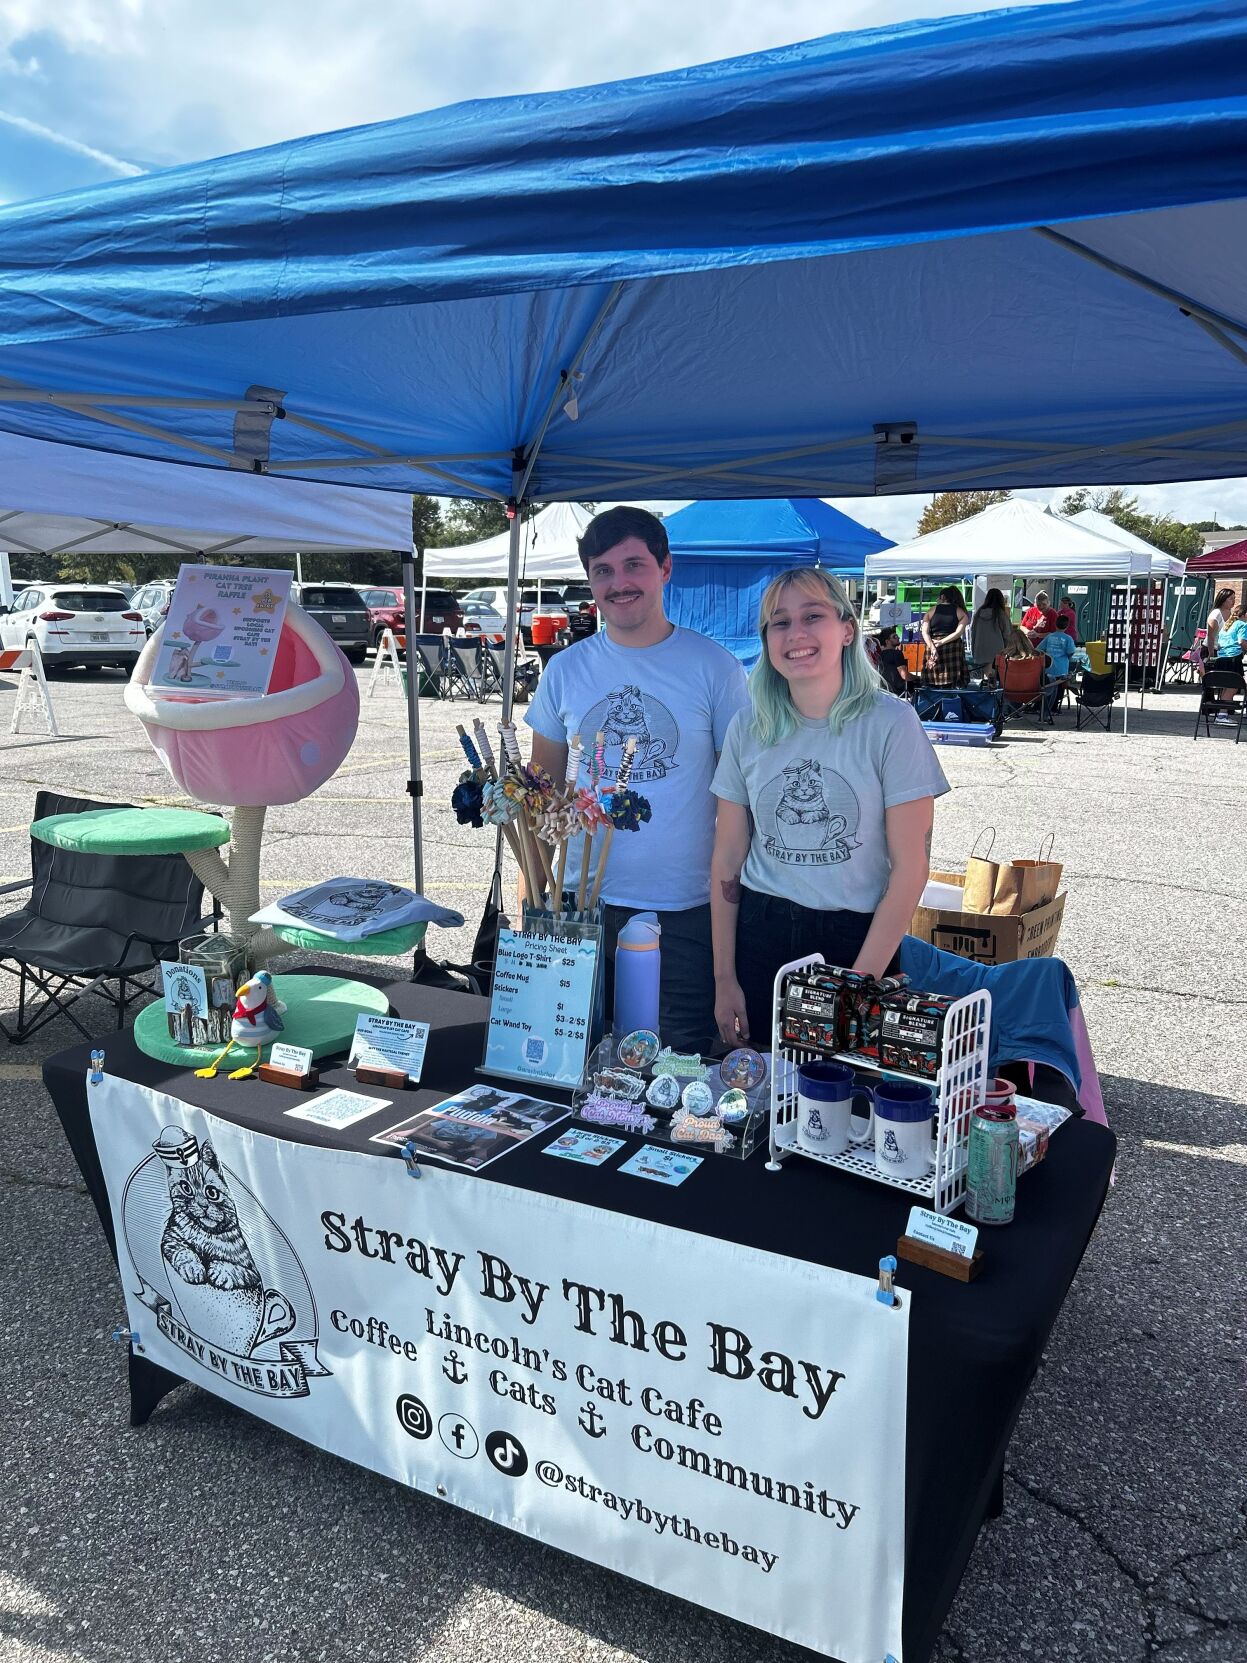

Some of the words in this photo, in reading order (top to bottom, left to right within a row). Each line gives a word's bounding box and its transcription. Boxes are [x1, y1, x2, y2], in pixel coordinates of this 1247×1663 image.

[216, 582, 230, 590] CAT
[218, 591, 246, 599] RAFFLE
[646, 769, 662, 778] BAY
[768, 846, 794, 861] STRAY
[795, 852, 808, 862] BY
[810, 853, 828, 863] THE
[830, 850, 847, 861] BAY
[513, 930, 536, 940] STRAY
[550, 934, 565, 944] THE
[568, 936, 582, 946] BAY
[525, 941, 547, 953] Pricing
[549, 944, 568, 954] Sheet
[498, 948, 512, 958] Blue
[513, 950, 528, 960] Logo
[530, 954, 552, 963] T-Shirt
[562, 958, 576, 966] $25
[166, 966, 202, 984] Donations
[496, 970, 515, 980] Coffee
[516, 974, 530, 983] Mug
[560, 980, 570, 988] $15
[494, 984, 518, 994] Stickers
[804, 989, 832, 998] SIGNATURE
[557, 1002, 564, 1010] $1
[556, 1014, 564, 1023] $3
[902, 1014, 934, 1024] SIGNATURE
[908, 1020, 926, 1028] BLEND
[502, 1020, 520, 1029] Wand
[522, 1022, 532, 1033] Toy
[554, 1028, 564, 1037] $5
[596, 1099, 631, 1112] Proud
[608, 1110, 634, 1122] Mom
[682, 1117, 720, 1128] Proud
[698, 1128, 724, 1141] Dad
[648, 1146, 668, 1154] Small
[670, 1152, 698, 1162] Stickers
[920, 1210, 937, 1220] Stray
[938, 1216, 946, 1224] By
[947, 1220, 958, 1229] The
[960, 1224, 972, 1234] Bay
[321, 1210, 465, 1296] Stray
[477, 1250, 549, 1325] By
[562, 1278, 688, 1361] The
[706, 1322, 846, 1420] Bay
[160, 1313, 205, 1361] STRAY
[208, 1350, 228, 1375] BY
[231, 1361, 265, 1390] THE
[266, 1367, 302, 1392] BAY
[425, 1308, 568, 1381] Lincoln's
[576, 1364, 632, 1406] Cat
[640, 1387, 723, 1436] Cafe
[330, 1310, 417, 1362] Coffee
[489, 1370, 557, 1416] Cats
[631, 1424, 860, 1530] Community
[534, 1460, 779, 1573] @straybythebay
